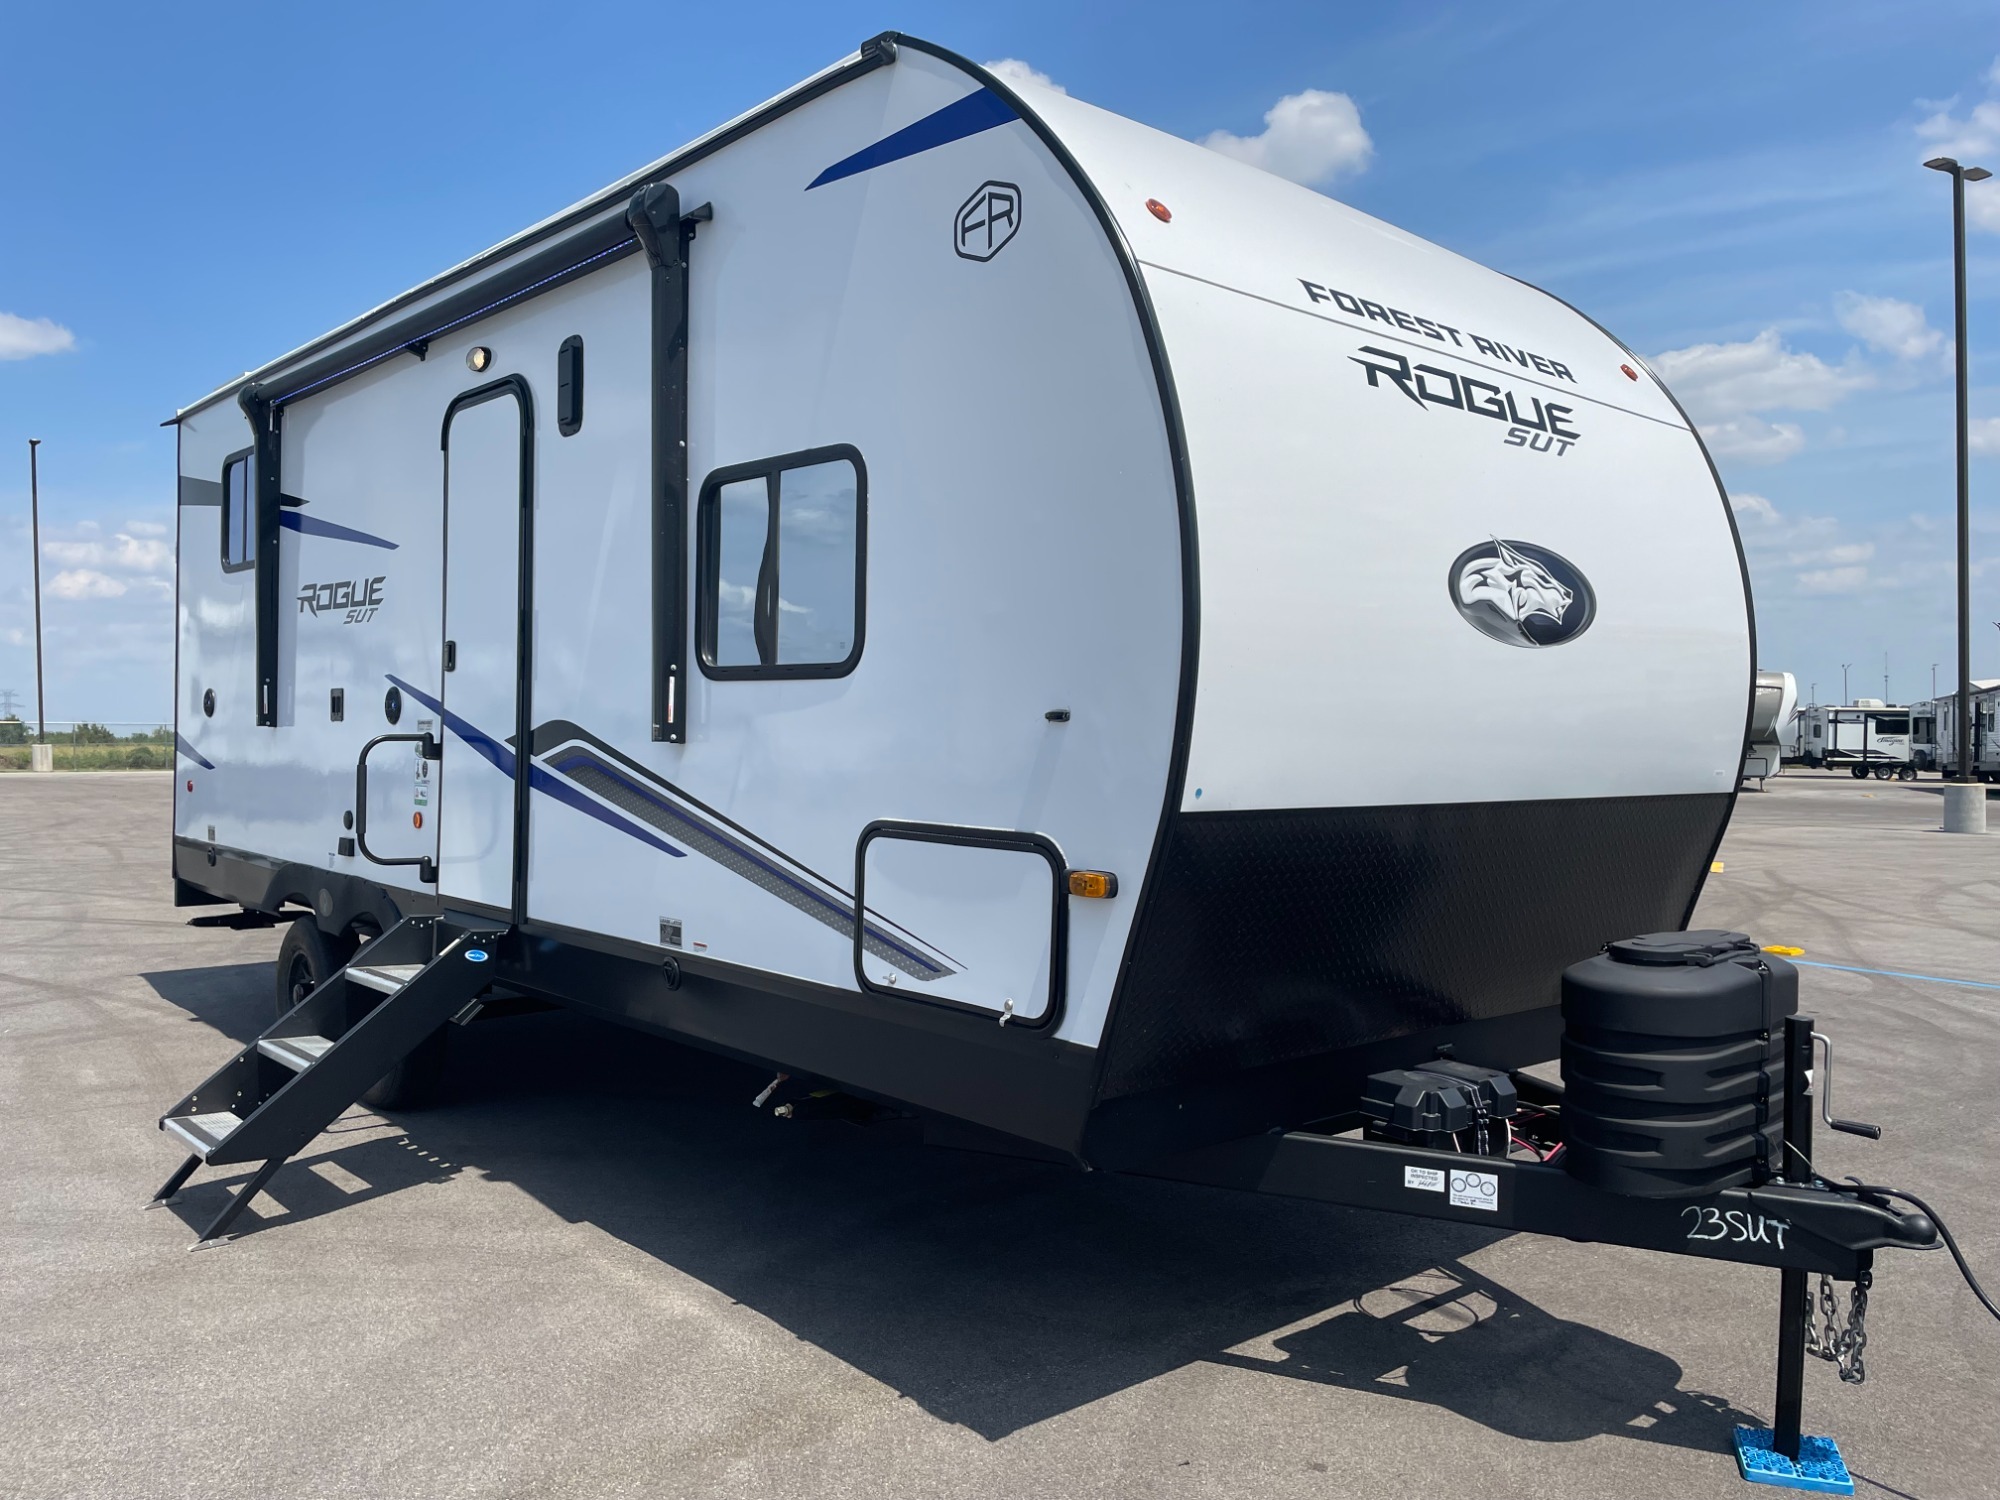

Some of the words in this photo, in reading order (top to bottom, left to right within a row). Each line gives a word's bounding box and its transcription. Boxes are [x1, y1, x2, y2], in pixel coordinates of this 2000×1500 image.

[1296, 277, 1461, 346] FOREST
[1468, 332, 1579, 384] RIVER
[1347, 345, 1582, 440] ROGUE
[1503, 427, 1576, 457] SUT
[296, 575, 387, 618] ROGUE
[343, 607, 379, 625] SUT
[1410, 1173, 1439, 1181] INSPECTED
[1680, 1205, 1791, 1250] 23SUT
